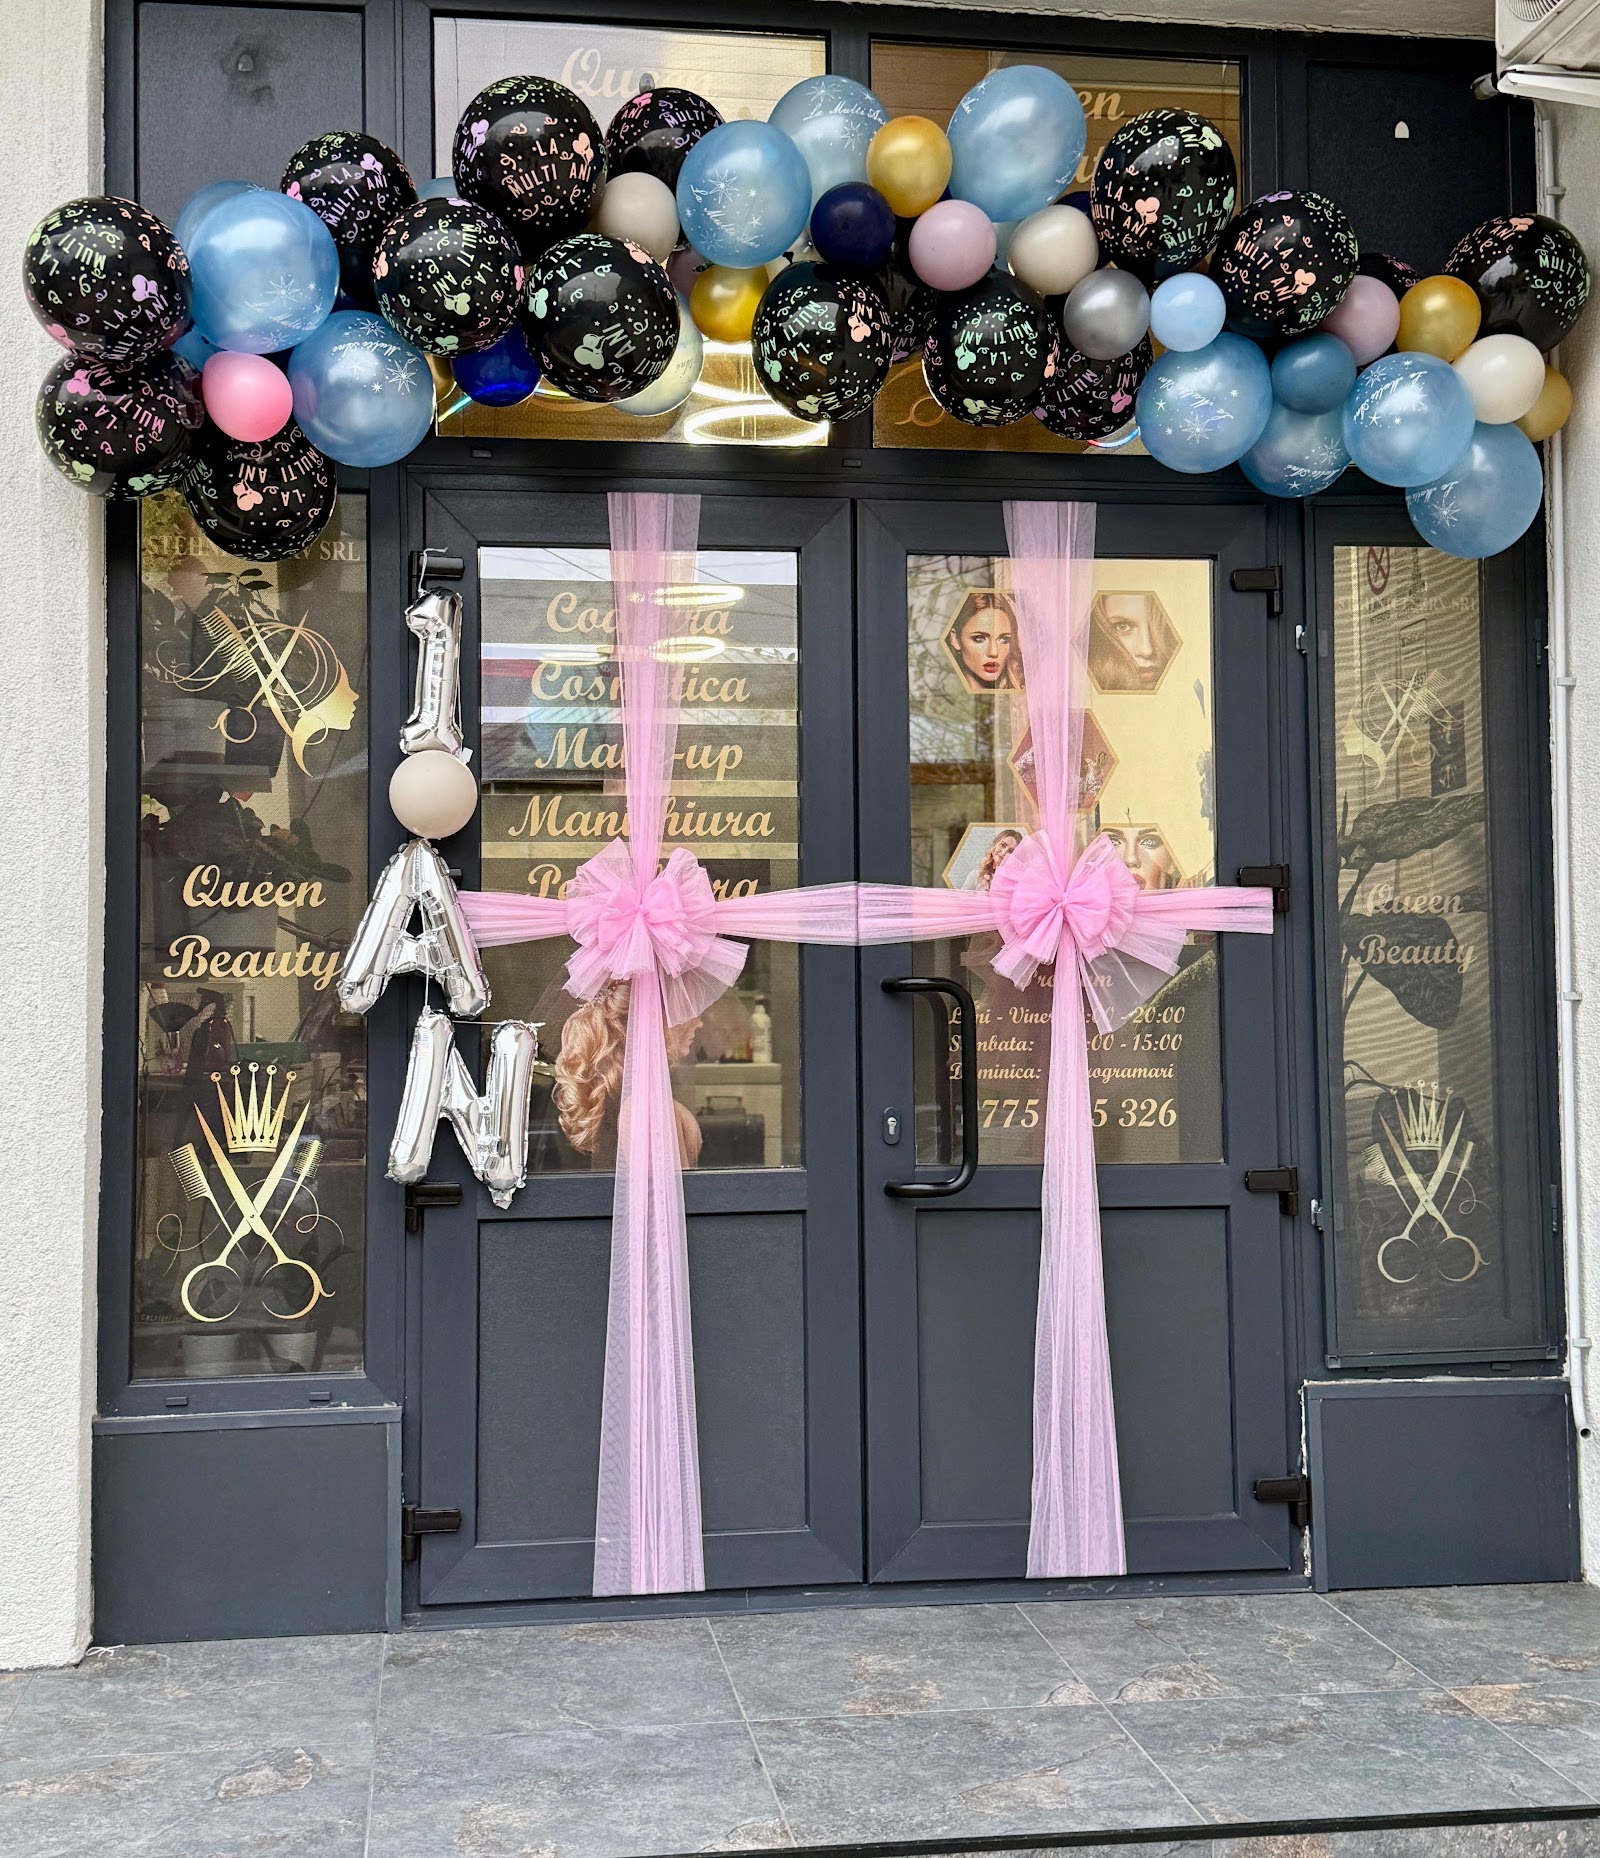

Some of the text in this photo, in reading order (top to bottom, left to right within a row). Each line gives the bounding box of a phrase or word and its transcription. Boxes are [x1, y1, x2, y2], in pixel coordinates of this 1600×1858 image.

[621, 108, 643, 120] ANI
[665, 109, 705, 128] MULTI
[536, 138, 559, 157] LA
[1176, 126, 1200, 148] ANI
[331, 167, 352, 185] LA
[507, 162, 592, 198] MULTI ANI
[325, 174, 388, 227] MULTI ANI
[1107, 181, 1123, 201] LA
[1197, 199, 1213, 217] LA
[1123, 216, 1148, 237] ANI
[1164, 222, 1208, 249] MULTI
[1489, 225, 1516, 240] ANI
[58, 233, 106, 271] MULTI
[432, 223, 477, 297] MULTI ANI
[1274, 237, 1294, 260] LA
[39, 250, 59, 277] LA
[474, 262, 493, 285] LA
[556, 259, 581, 281] LA
[1234, 238, 1293, 302] MULTI ANI
[1539, 255, 1576, 279] MULTI
[103, 309, 128, 329] LA
[783, 300, 821, 341] MULTI
[852, 301, 873, 319] ANI
[106, 326, 142, 361] MULTI
[145, 295, 168, 322] ANI
[960, 321, 1033, 345] MULTI ANI
[602, 323, 636, 359] ANI
[789, 342, 810, 362] LA
[990, 352, 1008, 366] LA
[1057, 369, 1097, 402] MULTI
[1117, 372, 1137, 388] ANI
[90, 362, 165, 434] MULTI ANI
[95, 404, 117, 430] LA
[1059, 406, 1079, 419] LA
[238, 447, 319, 483] MULTI ANI
[280, 488, 303, 506] LA
[320, 541, 361, 561] SRL
[531, 661, 750, 702] Costica
[534, 727, 743, 781] Ma-up
[508, 795, 775, 837] Manihiura
[182, 864, 326, 908] Queen
[1366, 884, 1464, 915] Queen
[163, 934, 341, 991] Beauty
[1357, 934, 1478, 973] Beauty
[949, 1006, 991, 1025] Lni
[1009, 1006, 1052, 1024] Vine
[1132, 1006, 1186, 1024] 20:00
[949, 1034, 1035, 1052] Smbata:
[1086, 1033, 1114, 1051] :00
[1132, 1033, 1183, 1051] 15:00
[949, 1062, 1042, 1080] Dminica:
[961, 1099, 1040, 1128] 775
[1118, 1098, 1178, 1128] 326
